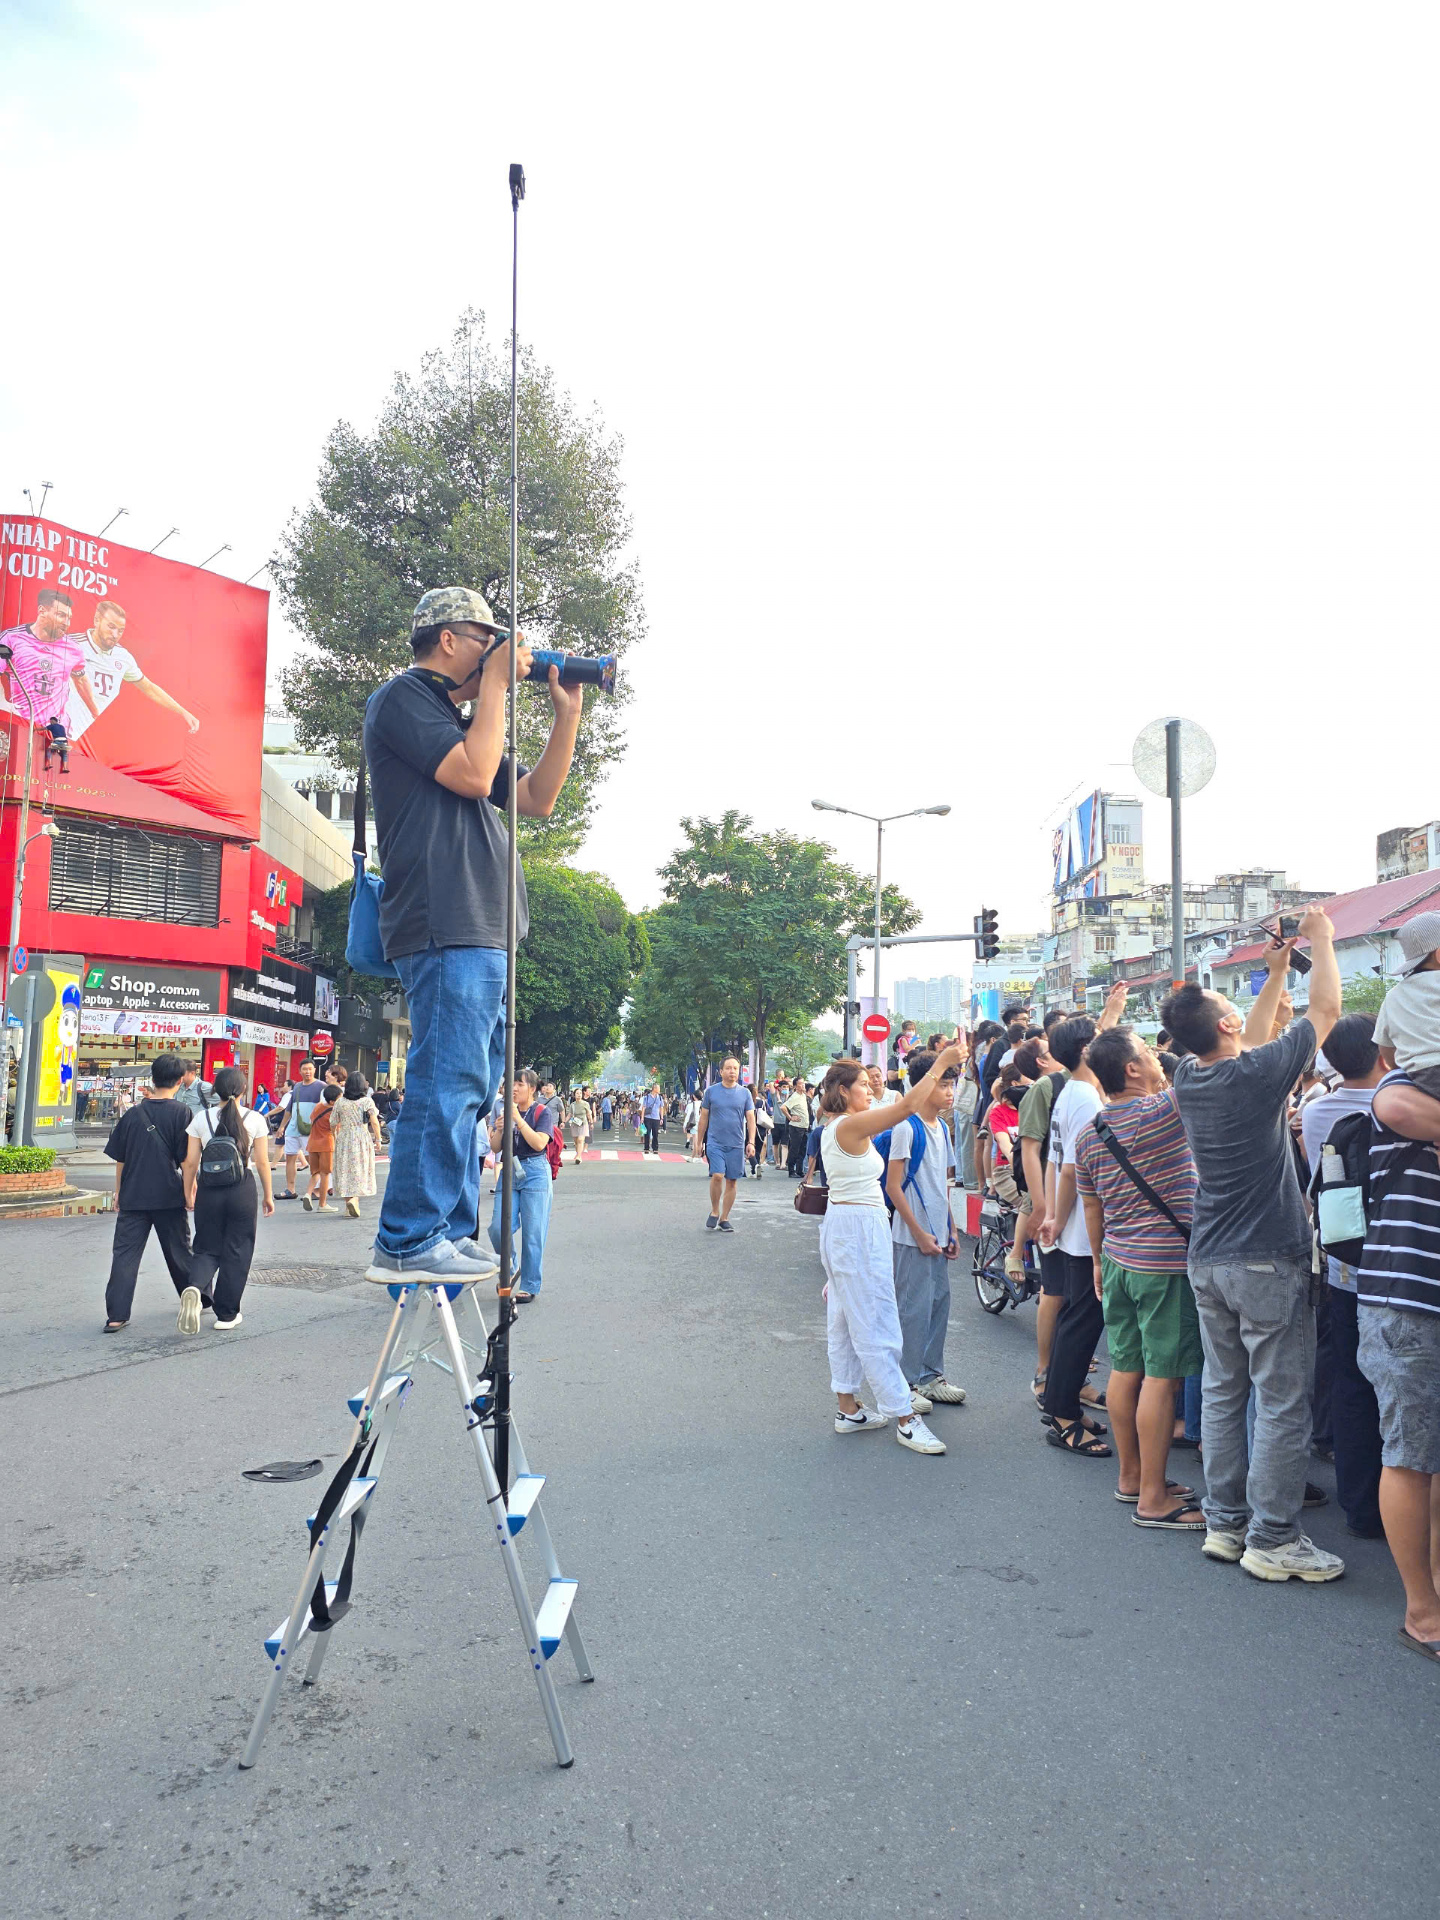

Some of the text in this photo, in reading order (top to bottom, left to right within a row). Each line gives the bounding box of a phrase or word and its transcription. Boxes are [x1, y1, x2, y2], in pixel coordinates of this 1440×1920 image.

[1, 522, 109, 568] NHẬP TIỆC
[8, 552, 53, 580] CUP
[0, 774, 40, 785] ORD
[82, 995, 113, 1006] aptop
[122, 995, 150, 1009] Apple
[160, 997, 210, 1011] Accessories
[150, 1021, 181, 1036] Triệu
[194, 1024, 214, 1035] 0%
